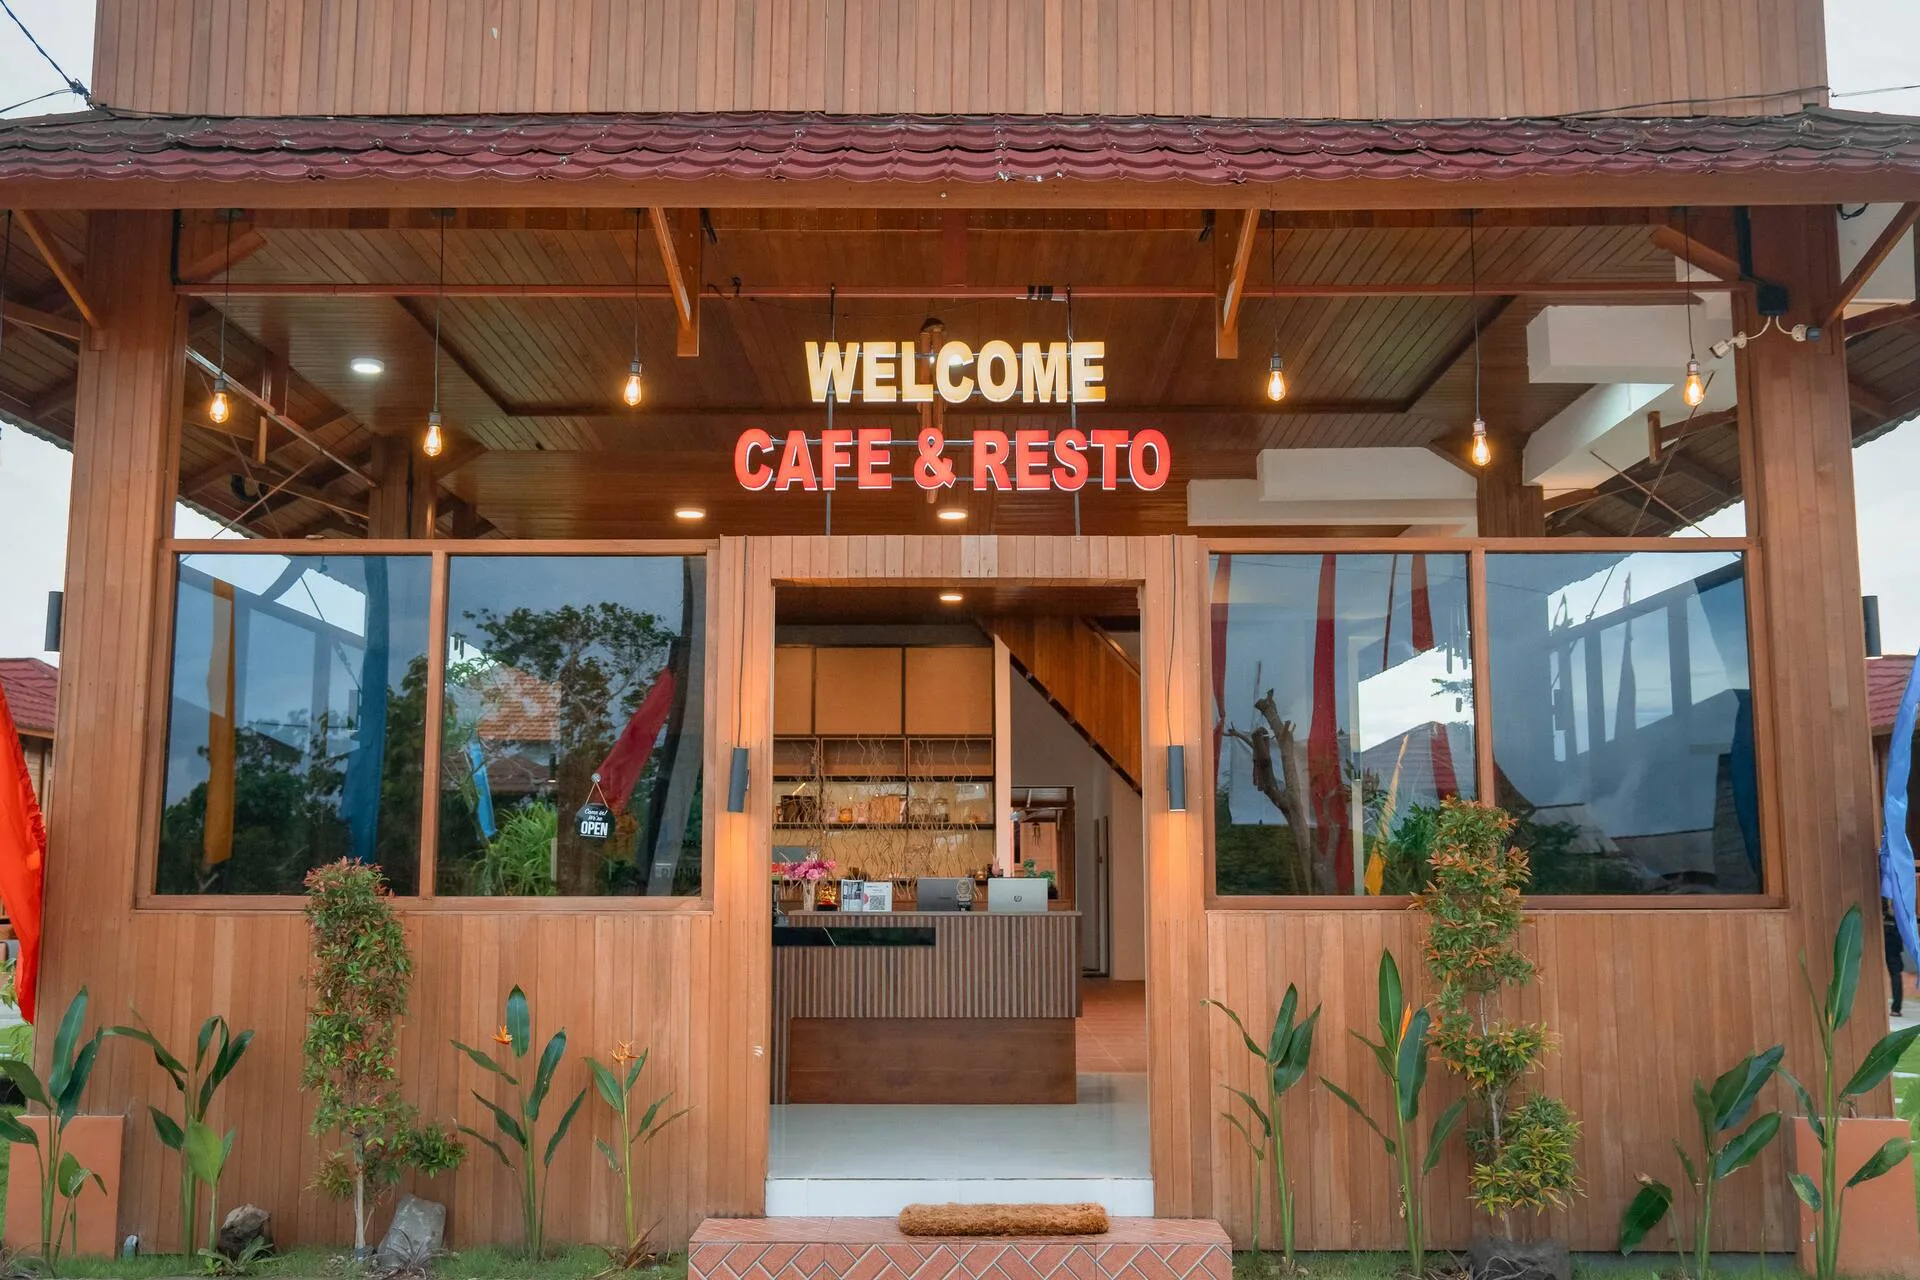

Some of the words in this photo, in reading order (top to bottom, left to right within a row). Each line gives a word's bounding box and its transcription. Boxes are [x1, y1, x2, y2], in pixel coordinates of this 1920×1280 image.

[804, 340, 1106, 403] WELCOME
[734, 428, 893, 491] CAFE
[913, 427, 956, 489] &
[972, 428, 1171, 492] RESTO
[580, 821, 608, 836] OPEN
